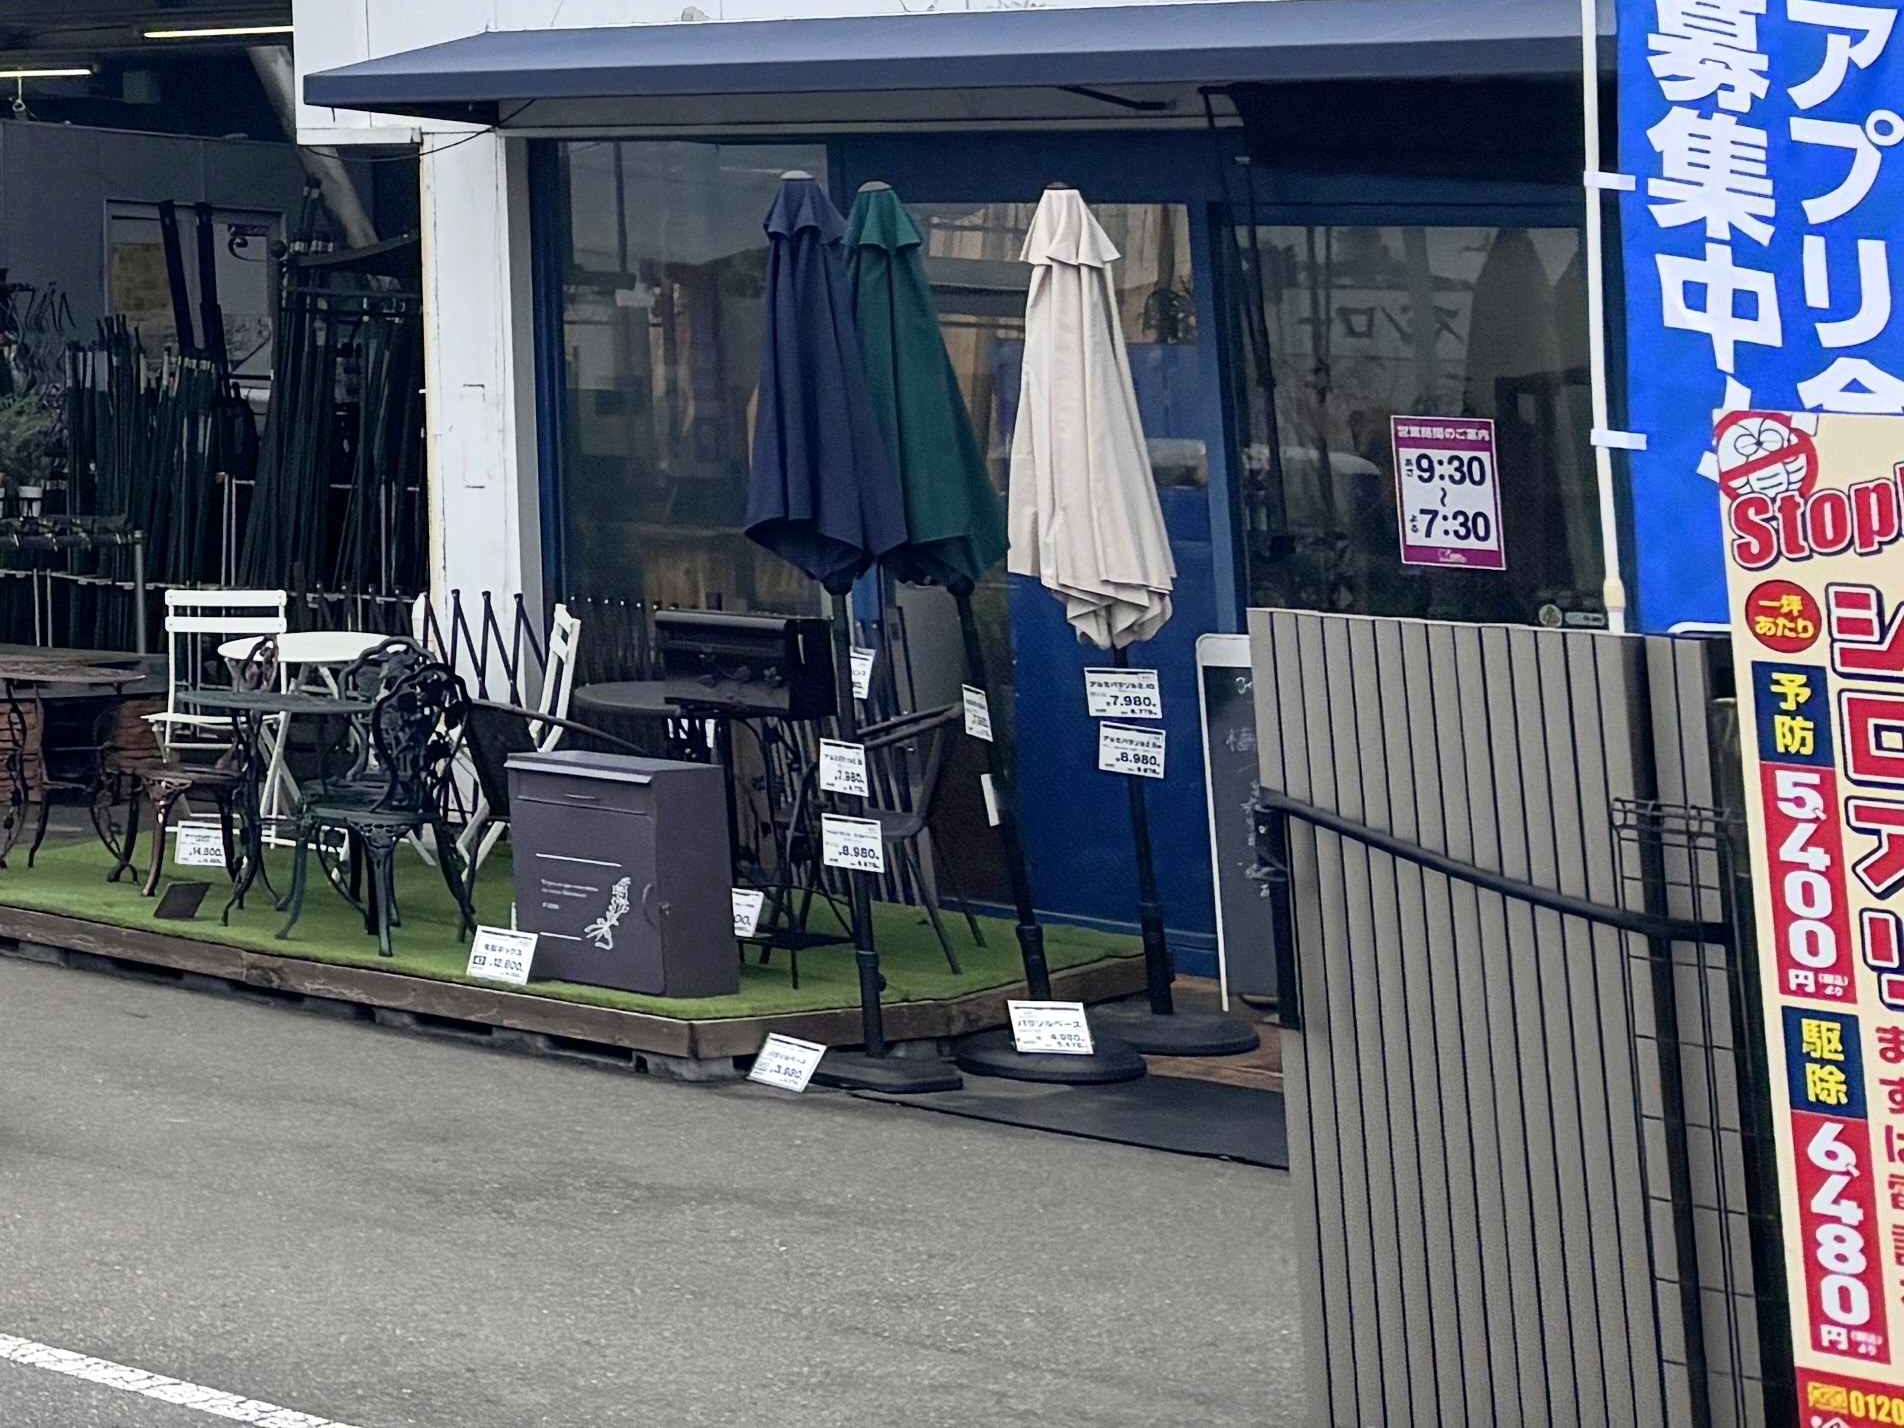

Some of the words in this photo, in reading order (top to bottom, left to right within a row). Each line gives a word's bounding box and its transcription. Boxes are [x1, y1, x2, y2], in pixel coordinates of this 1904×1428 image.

[1415, 452, 1486, 487] 9:30
[1419, 508, 1491, 542] 7:30
[1729, 460, 1904, 571] Stop
[1758, 595, 1804, 617] 一坪
[1754, 615, 1815, 639] あたり
[1769, 672, 1815, 757] 予防
[1801, 1018, 1848, 1106] 駆除
